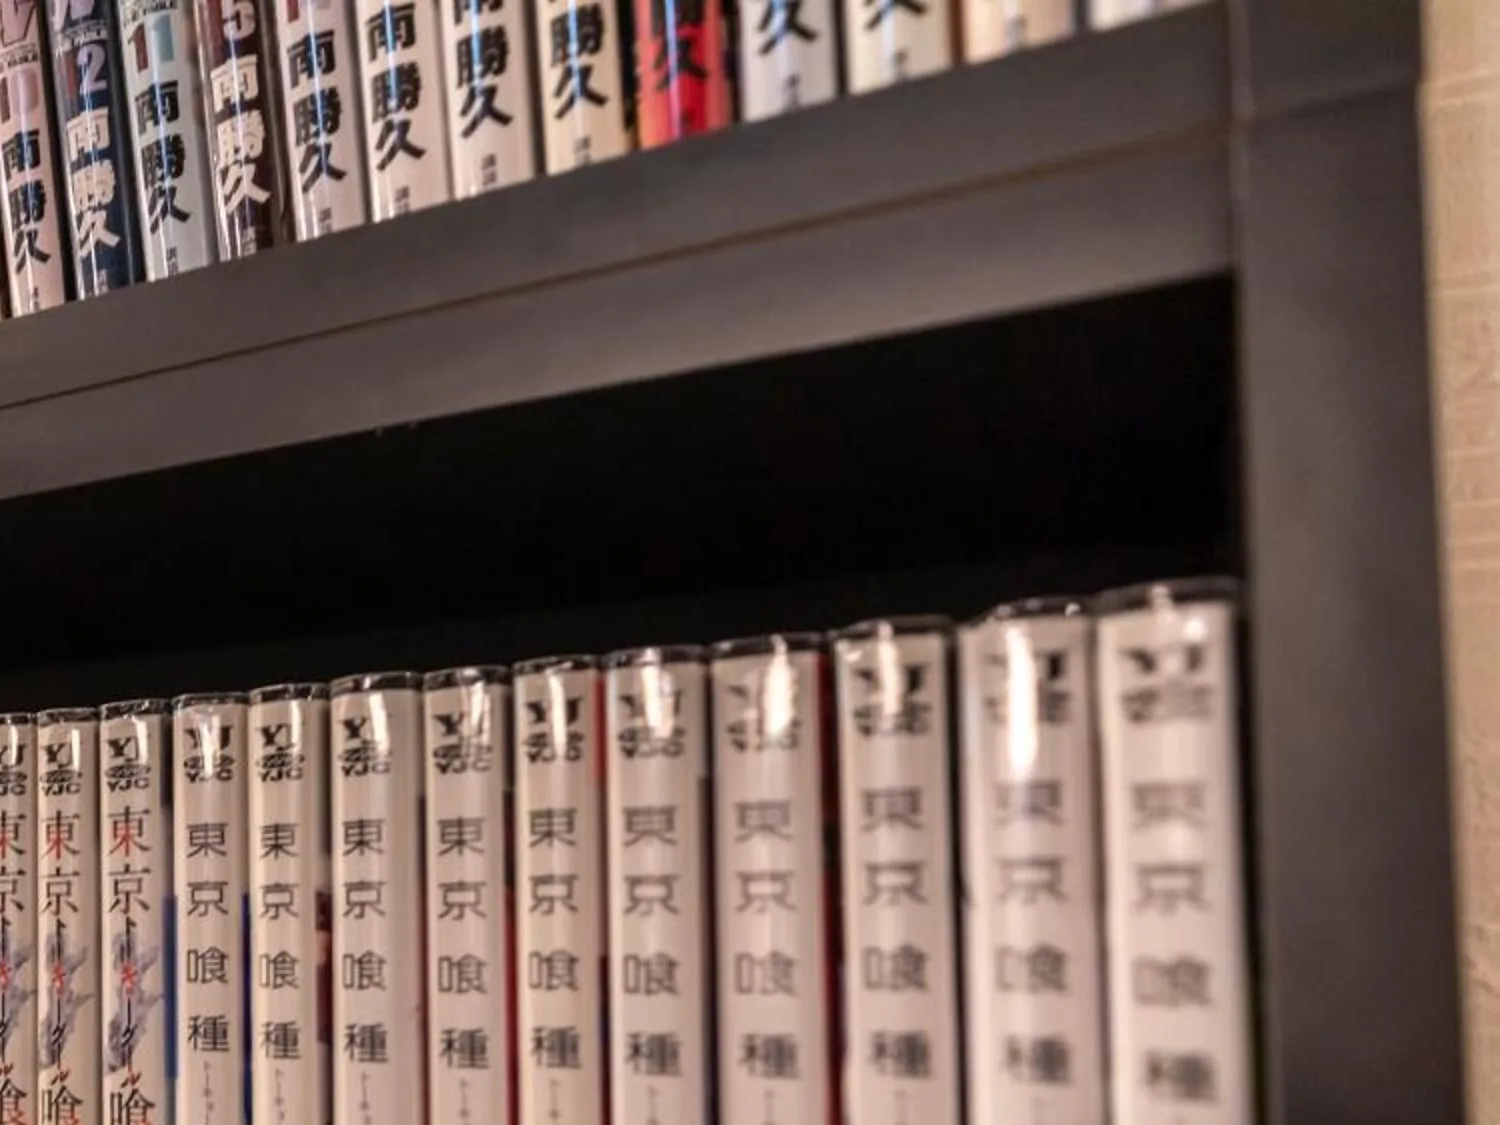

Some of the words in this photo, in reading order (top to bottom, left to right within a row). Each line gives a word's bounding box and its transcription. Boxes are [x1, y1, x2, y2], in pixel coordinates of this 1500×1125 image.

[128, 14, 174, 73] 11
[135, 80, 191, 235] 南勝久
[211, 55, 271, 214] 南勝久
[288, 29, 347, 194] 南勝久
[2, 130, 52, 274] 南勝久
[186, 822, 231, 1053] 東京喰種
[260, 822, 302, 1060] 東京喰種
[342, 818, 388, 1064] 東京喰種
[437, 816, 489, 1070] 東京喰種
[528, 807, 581, 1070] 東京喰種
[623, 804, 681, 1077] 東京喰種
[734, 799, 799, 1080] 東京喰種
